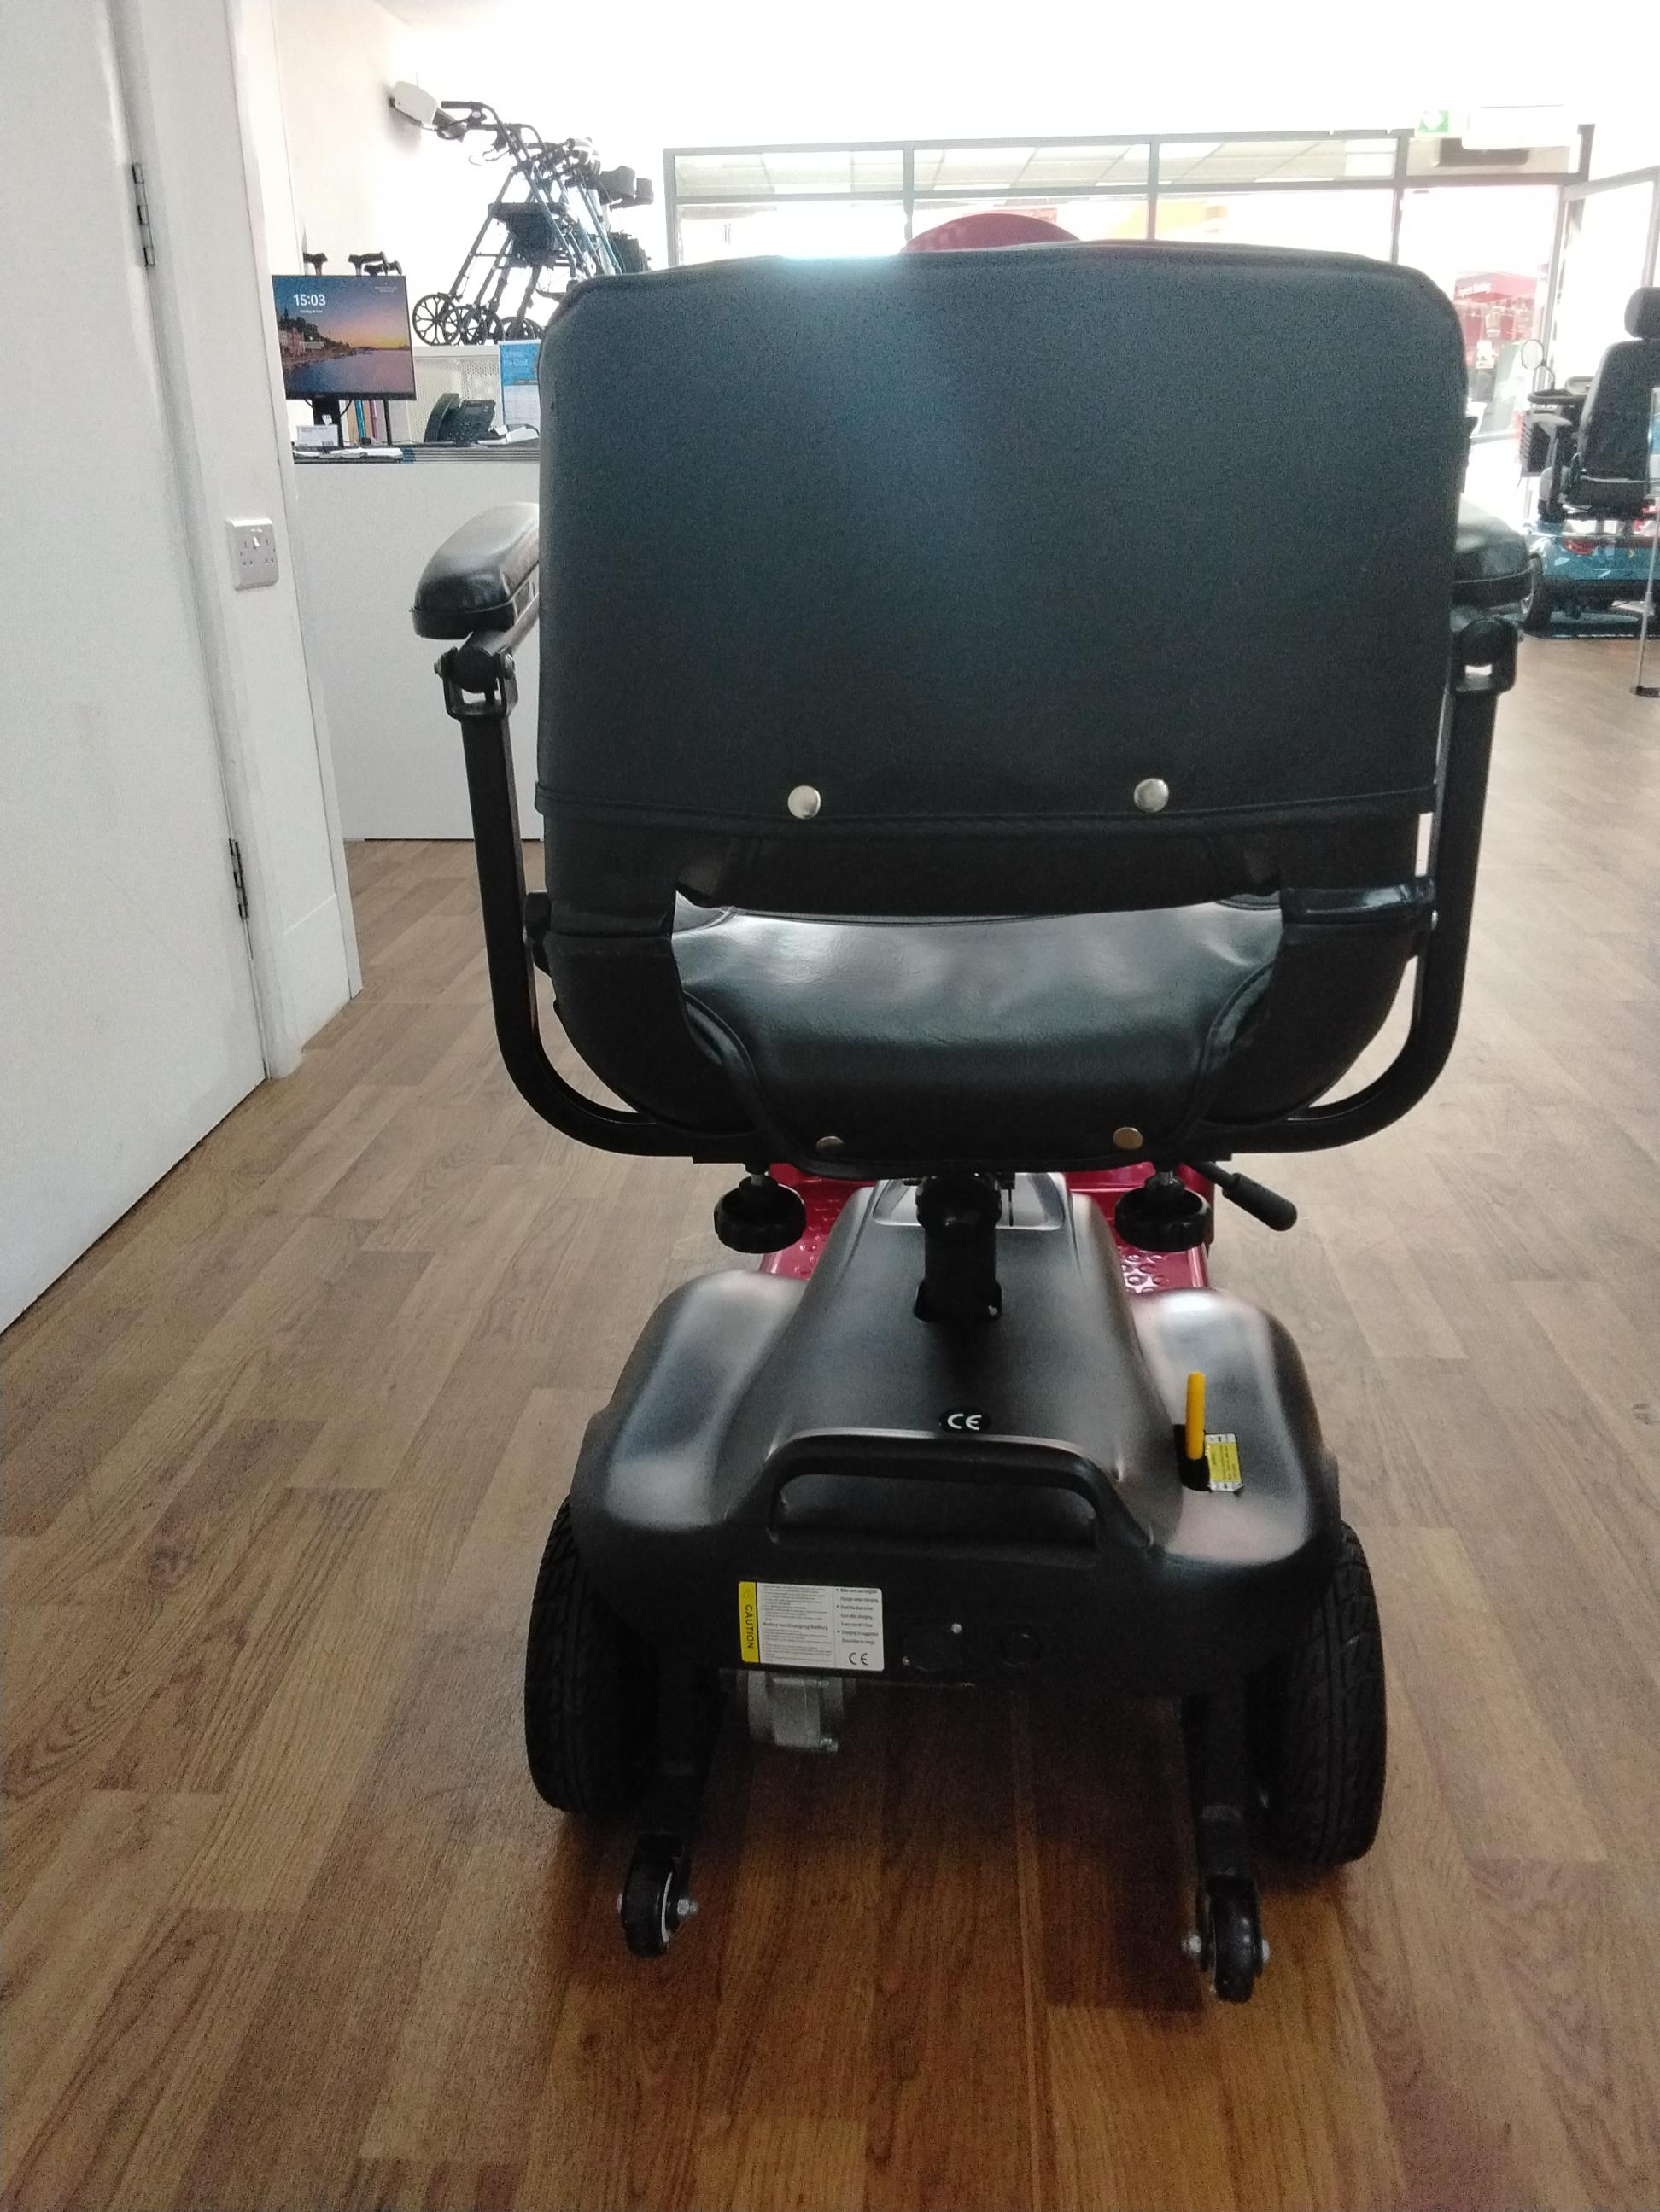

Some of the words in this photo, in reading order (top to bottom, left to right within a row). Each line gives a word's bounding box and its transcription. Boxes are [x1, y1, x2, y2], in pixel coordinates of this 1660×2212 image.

[294, 294, 326, 306] 15:03
[947, 1413, 982, 1431] CE
[745, 1604, 755, 1649] CAUTION
[849, 1652, 868, 1666] CE
